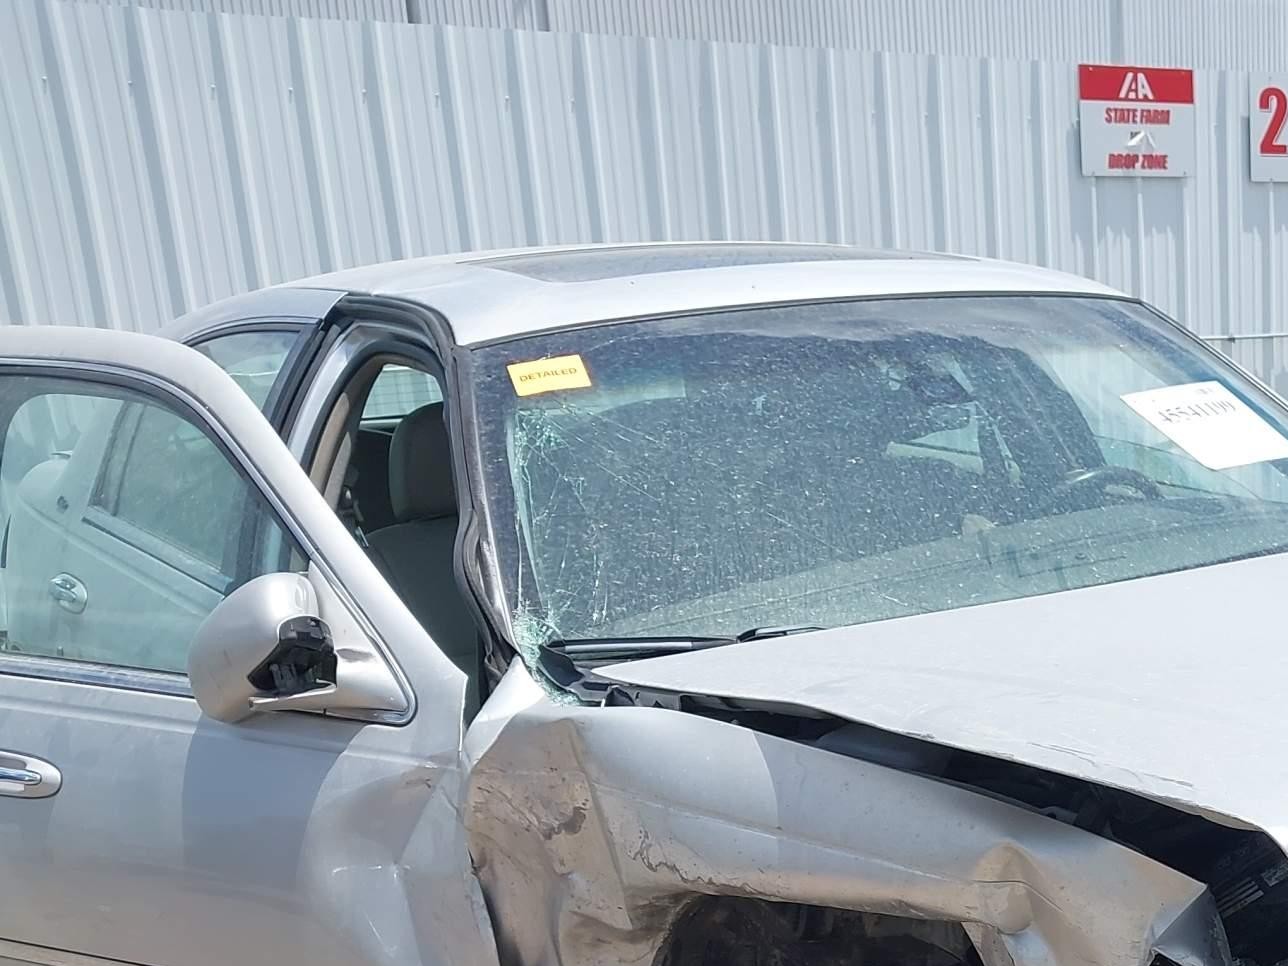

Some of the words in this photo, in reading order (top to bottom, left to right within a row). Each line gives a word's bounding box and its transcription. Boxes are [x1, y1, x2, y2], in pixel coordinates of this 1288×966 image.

[1104, 107, 1139, 125] STATE
[1140, 109, 1170, 125] FARM
[1108, 154, 1139, 170] DROP
[1140, 154, 1168, 170] ZONE
[519, 367, 577, 382] DETAILED
